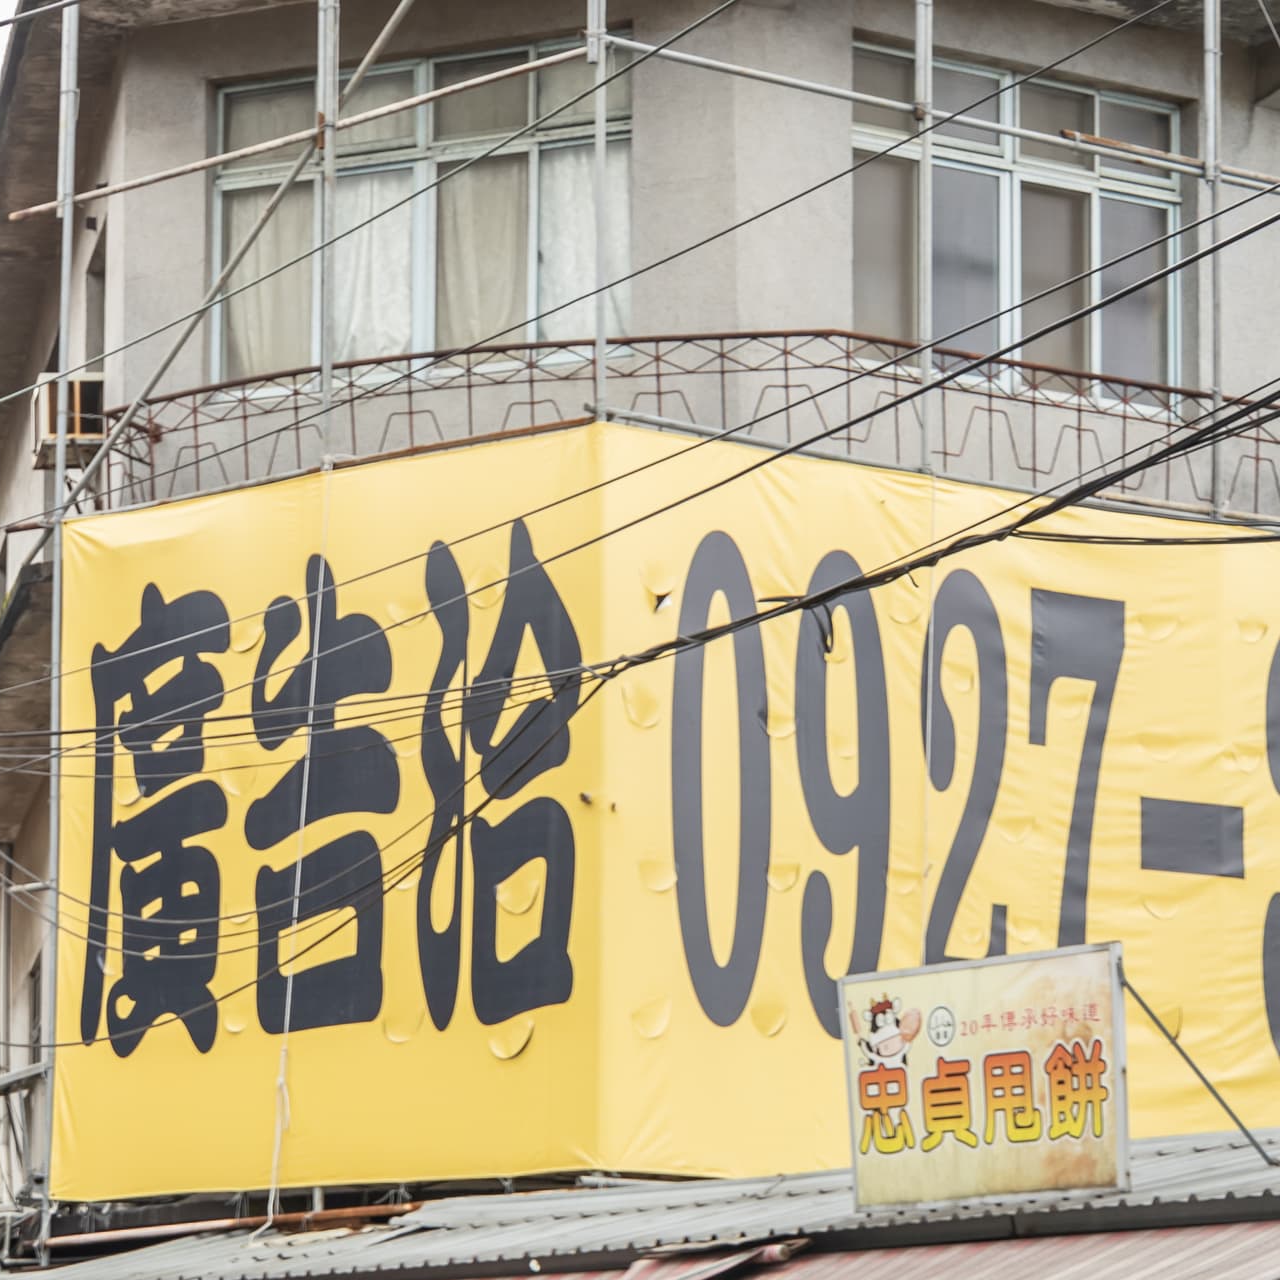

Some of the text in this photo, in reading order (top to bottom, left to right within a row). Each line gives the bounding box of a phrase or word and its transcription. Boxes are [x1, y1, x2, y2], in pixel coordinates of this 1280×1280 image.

[80, 517, 582, 1059] 廣告洽
[672, 530, 1280, 1041] 0927-
[858, 1038, 1109, 1154] 忠貞甩餅
